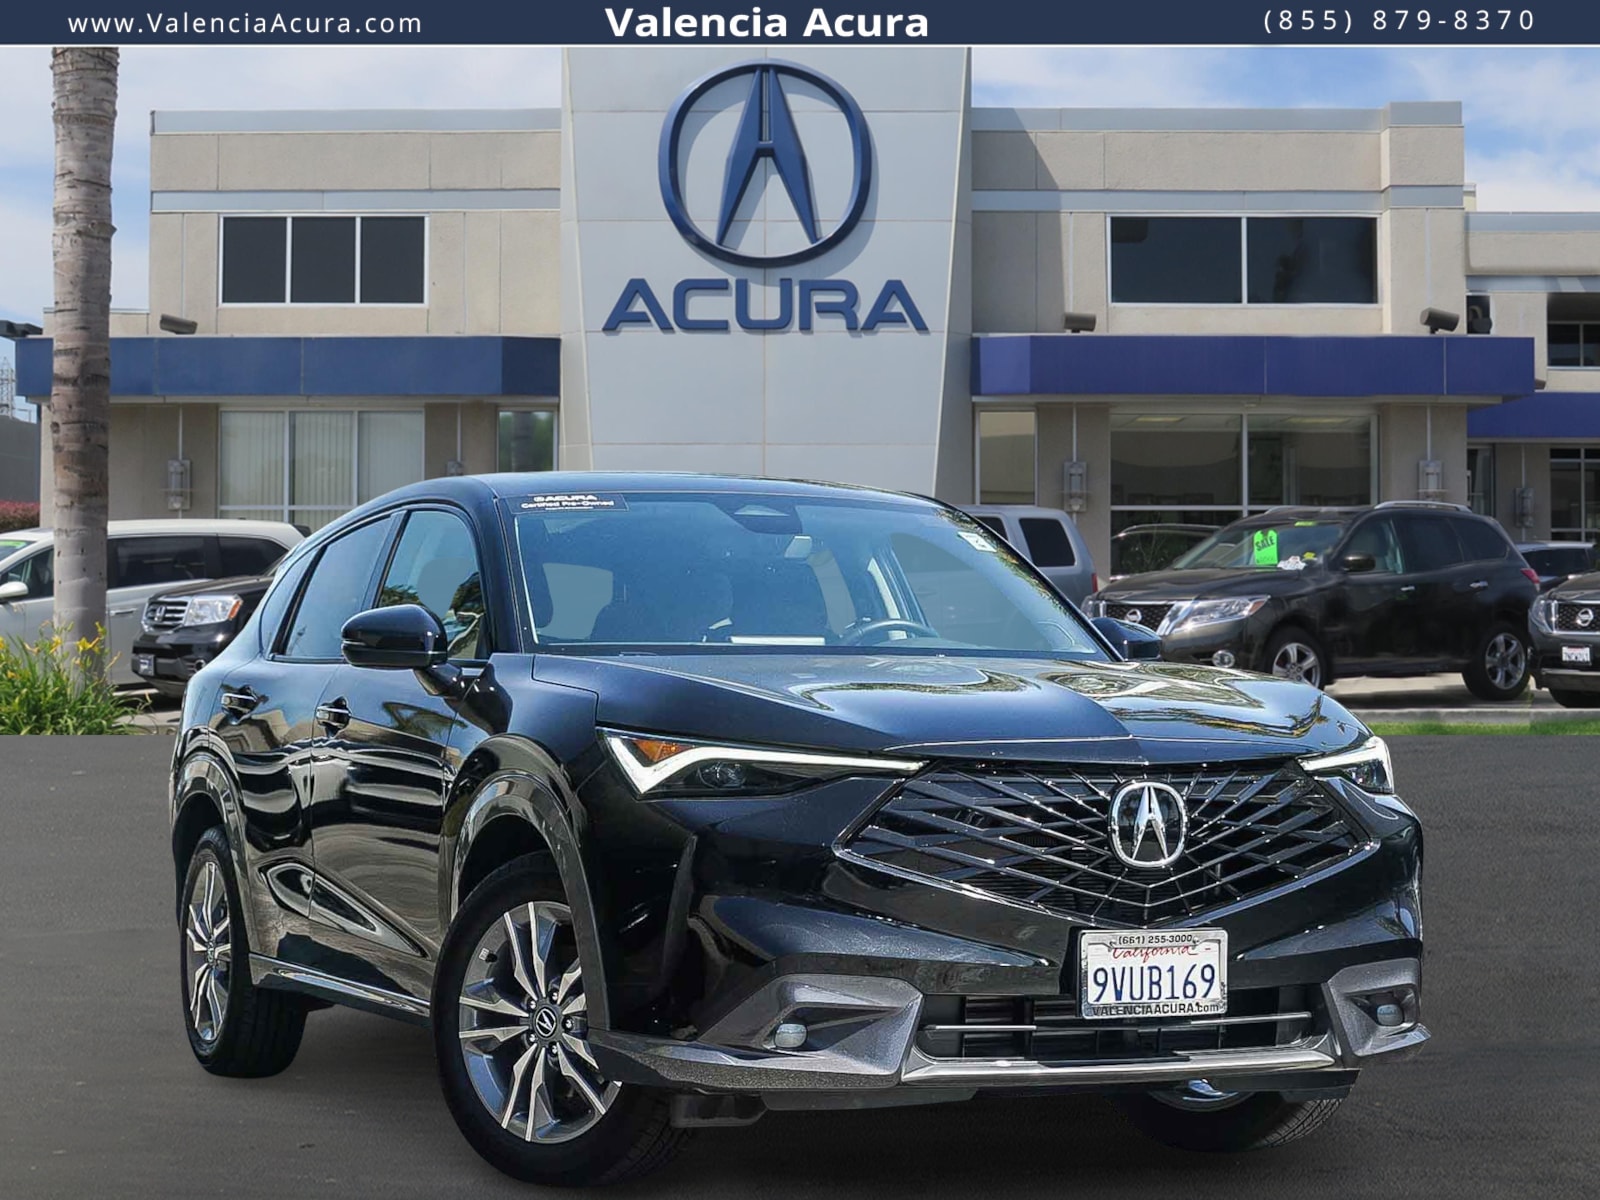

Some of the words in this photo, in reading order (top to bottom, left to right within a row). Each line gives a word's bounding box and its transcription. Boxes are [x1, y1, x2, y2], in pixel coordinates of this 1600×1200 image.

[602, 277, 930, 333] ACURA
[1255, 535, 1276, 552] SALE
[1118, 935, 1146, 945] (661)
[1147, 934, 1193, 944] 255-3000
[1112, 945, 1199, 964] California
[1093, 963, 1215, 1003] 9VUB169
